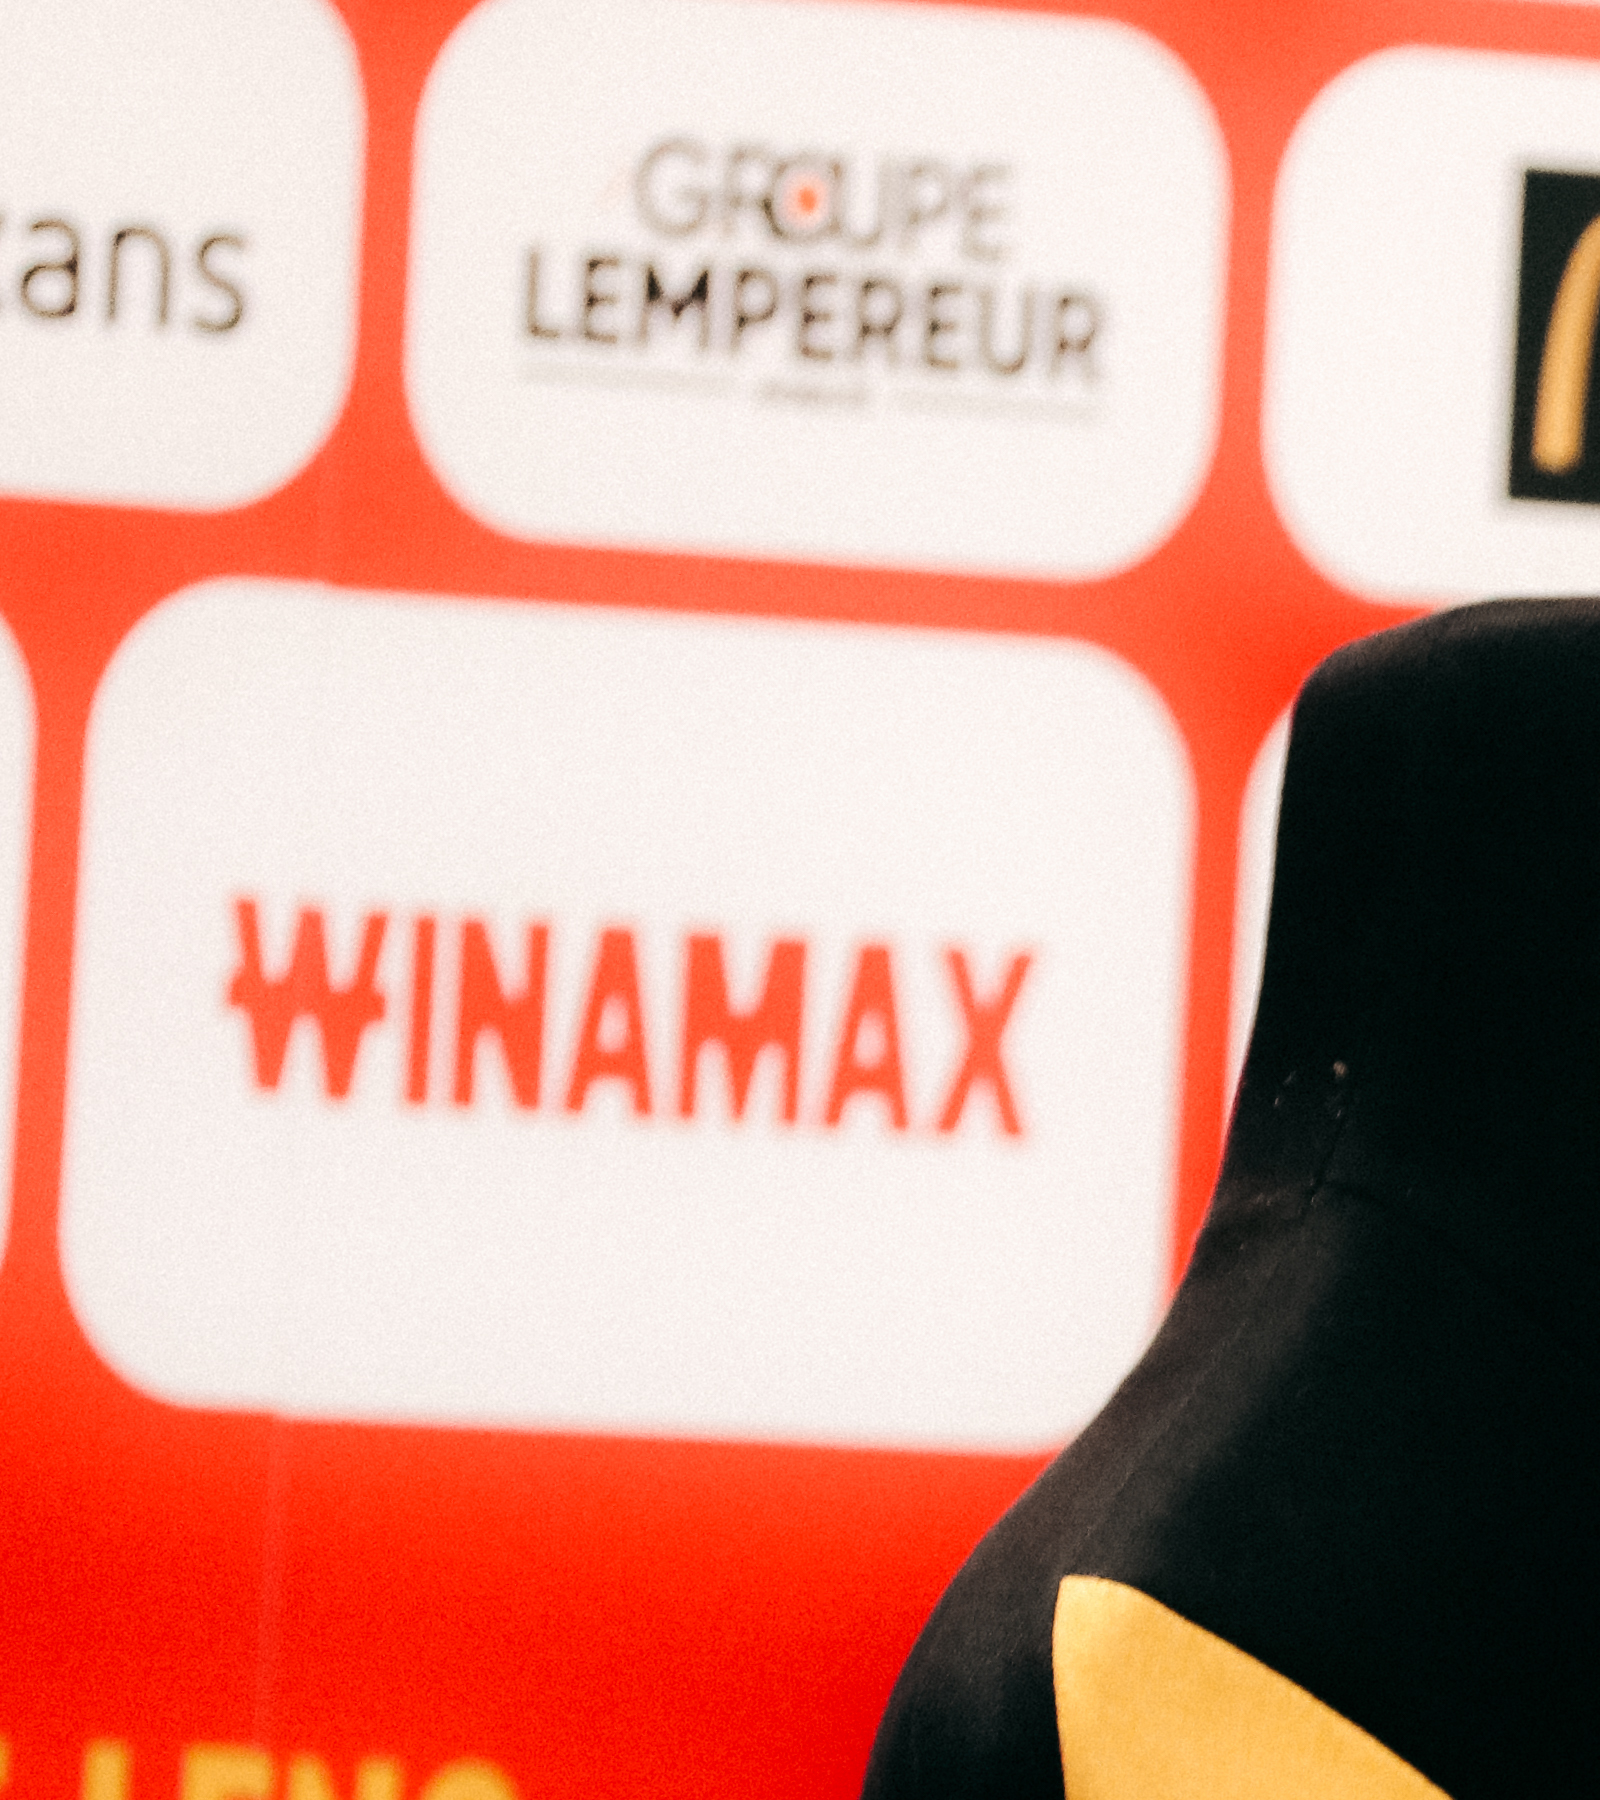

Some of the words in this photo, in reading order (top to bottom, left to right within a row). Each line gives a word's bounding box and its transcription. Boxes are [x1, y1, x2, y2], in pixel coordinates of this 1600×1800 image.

[630, 135, 1014, 262] GROUPE
[0, 212, 250, 338] ans
[520, 242, 1106, 384] LEMPEREUR
[226, 896, 1035, 1140] WINAMAX
